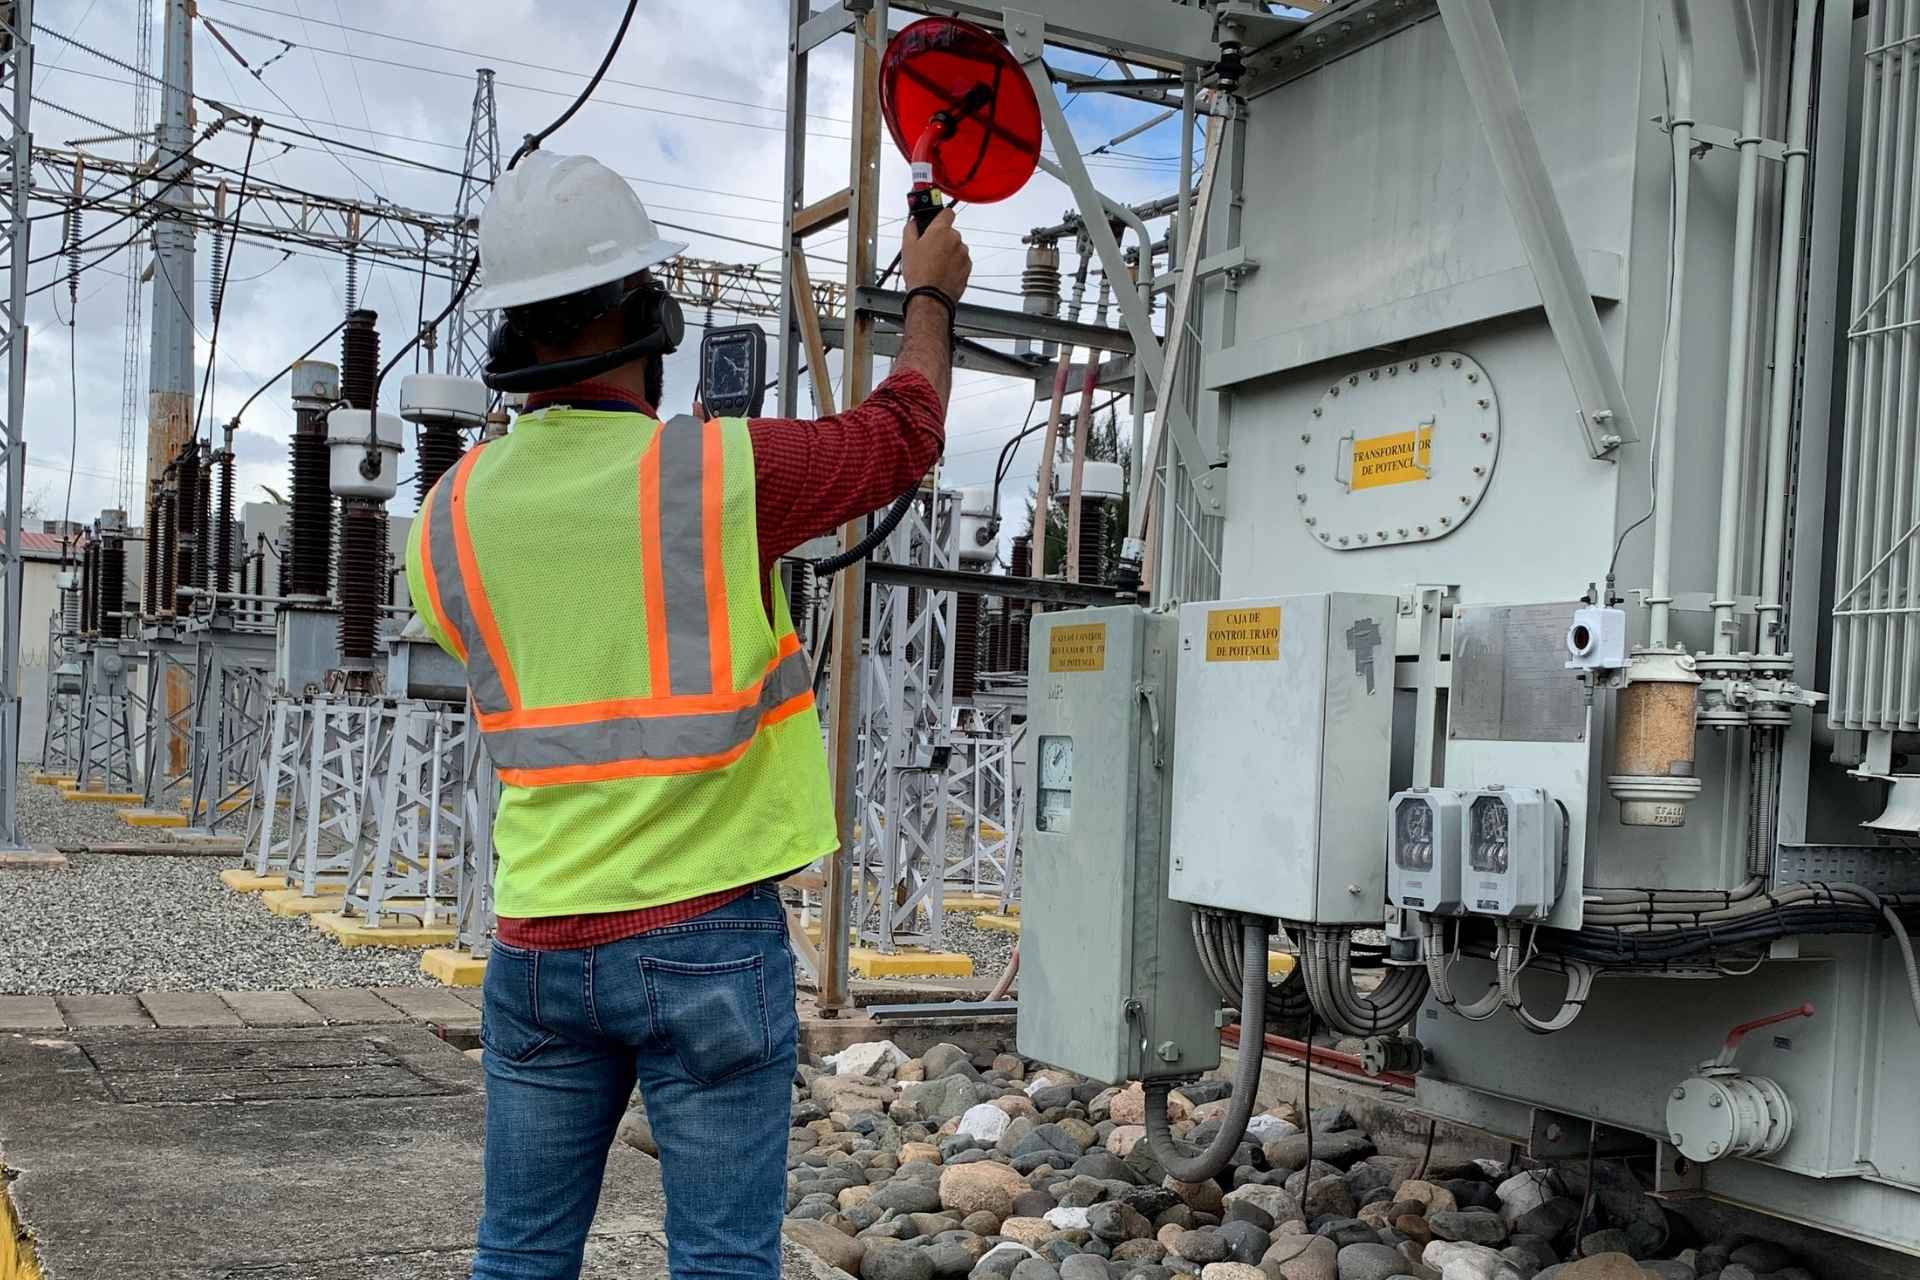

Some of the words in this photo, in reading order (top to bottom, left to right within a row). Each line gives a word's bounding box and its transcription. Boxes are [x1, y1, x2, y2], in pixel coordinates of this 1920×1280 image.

[1361, 464, 1374, 476] DE
[1375, 457, 1416, 474] POTENCI
[1226, 614, 1247, 625] CAJA
[1249, 612, 1261, 623] DE
[1209, 630, 1247, 641] CONTROL
[1250, 628, 1278, 640] TRAFO
[1216, 647, 1227, 657] DE
